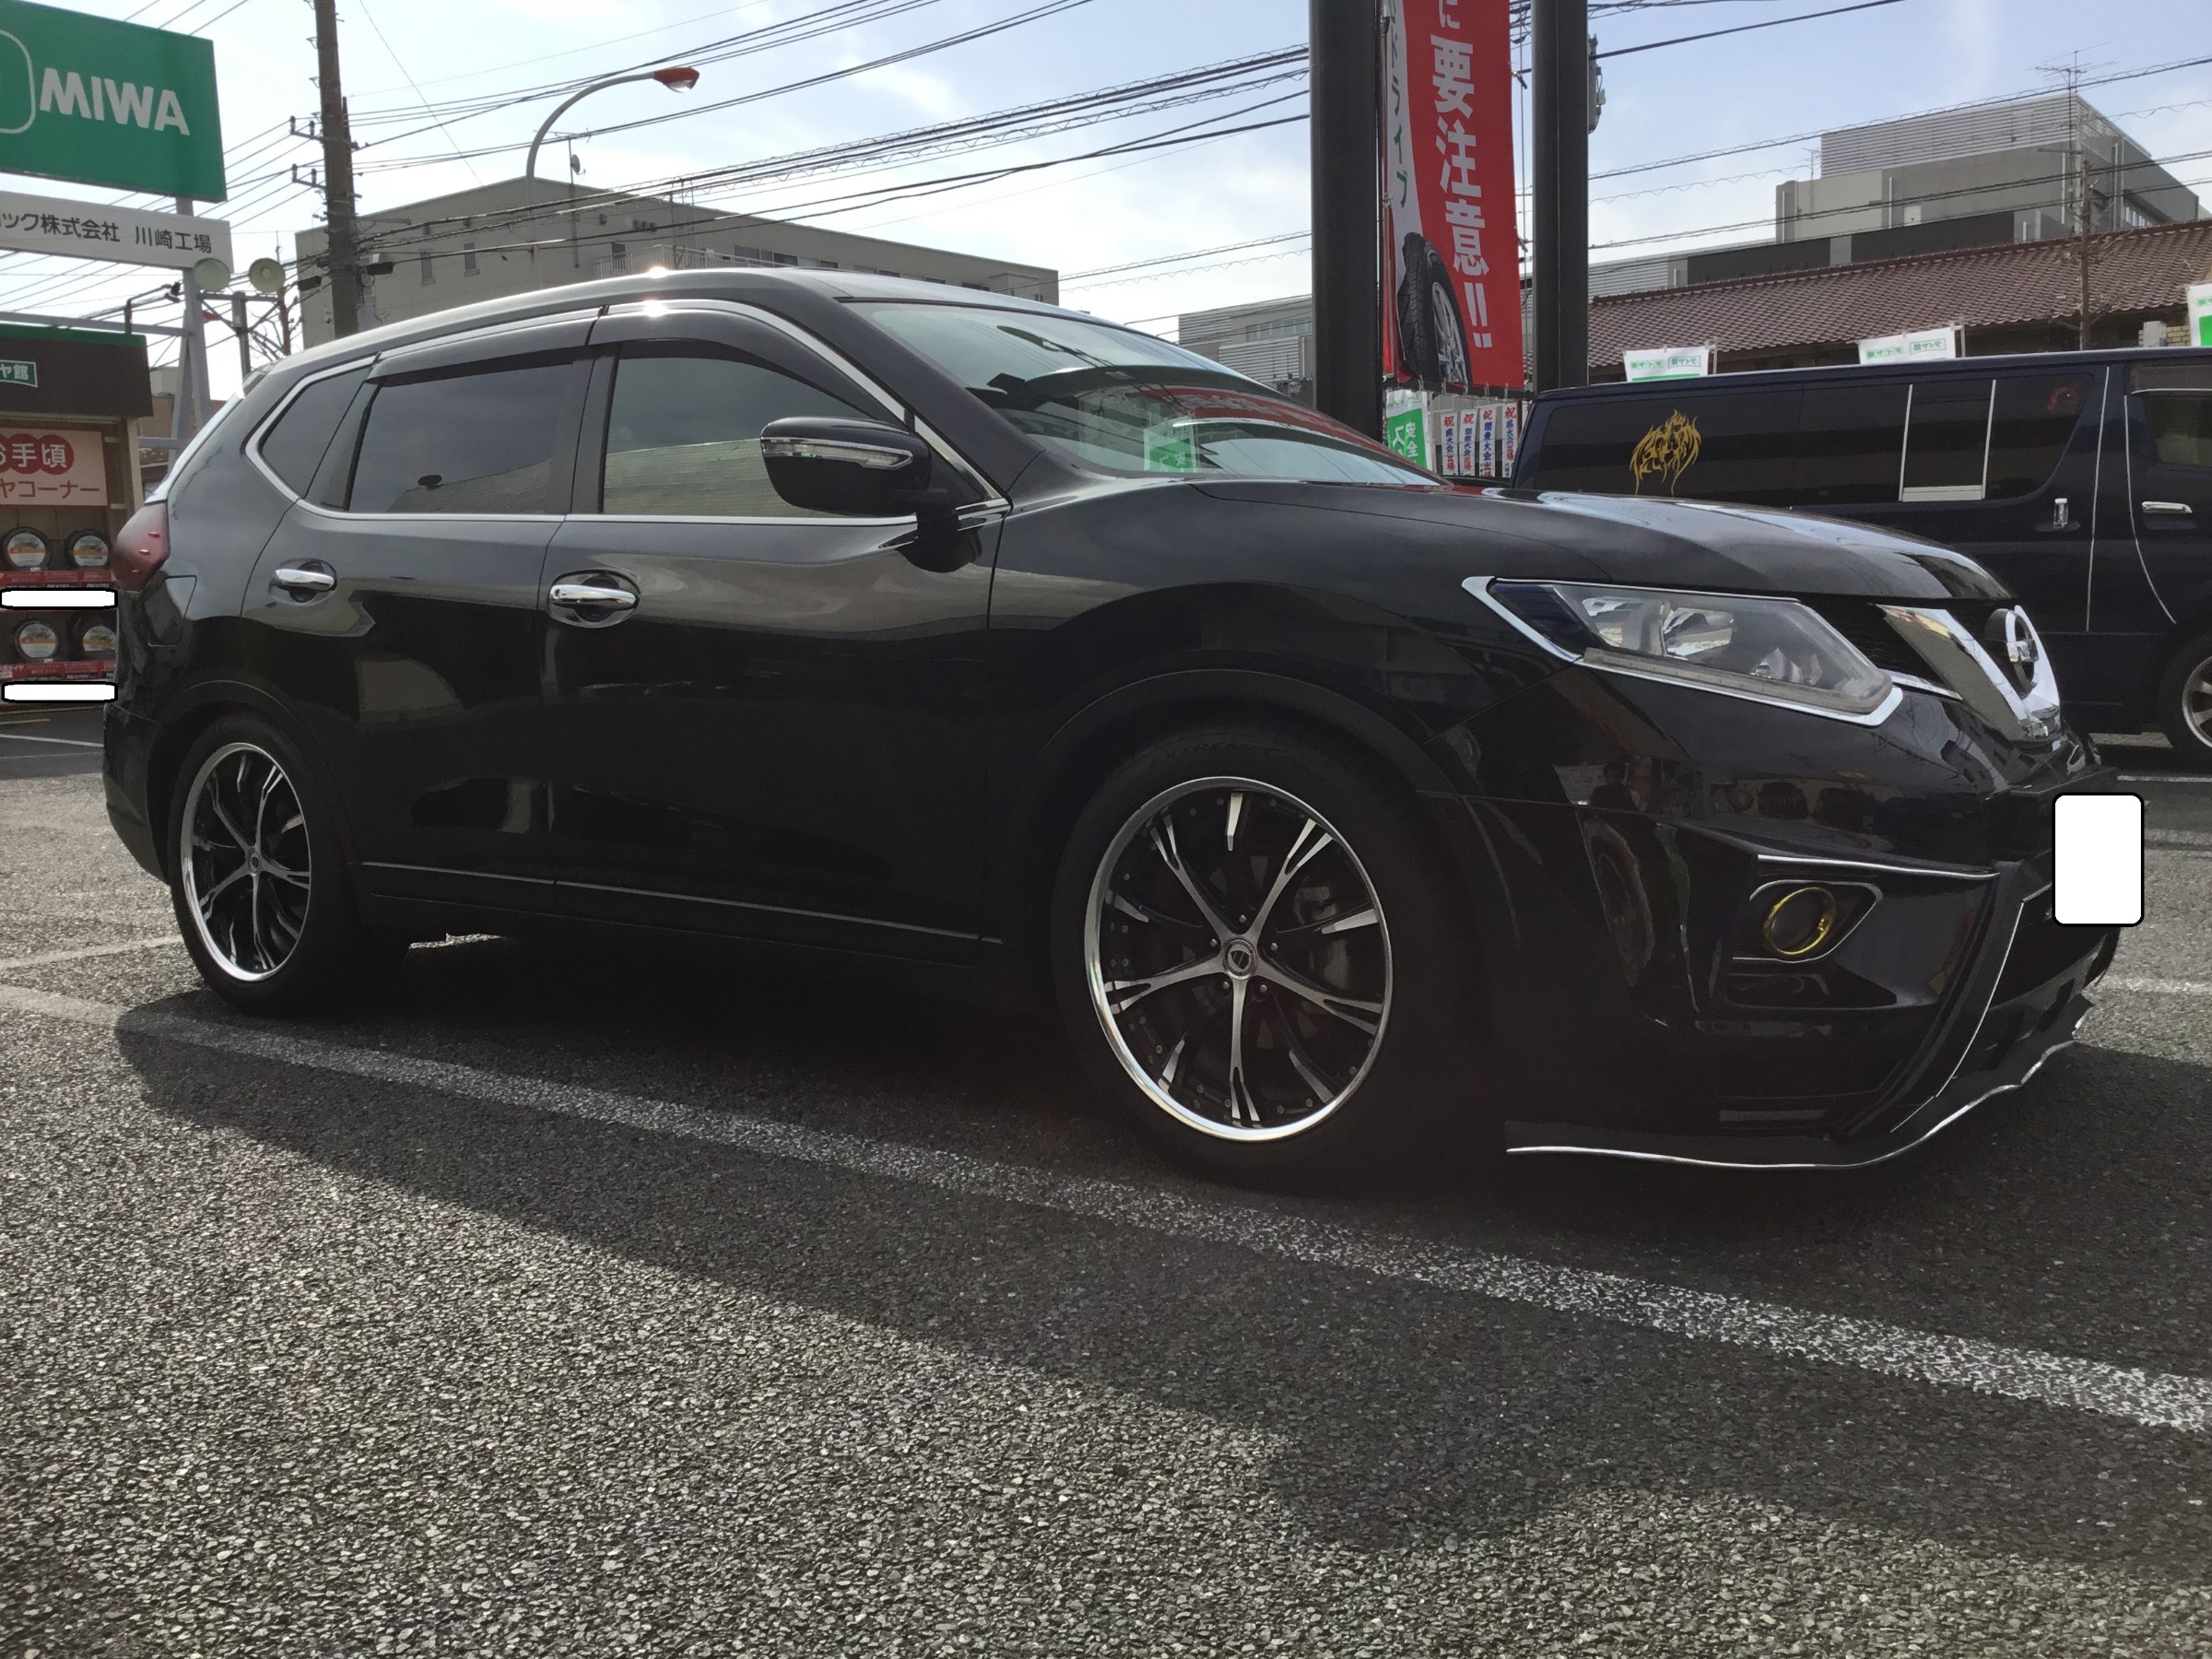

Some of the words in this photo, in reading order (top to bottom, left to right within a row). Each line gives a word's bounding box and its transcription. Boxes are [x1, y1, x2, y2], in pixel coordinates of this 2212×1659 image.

[40, 67, 191, 135] MIWA
[0, 212, 121, 242] ック株式会社
[135, 226, 212, 254] 川崎工場
[0, 443, 67, 468] 手頃
[0, 479, 100, 499] ヤコーナー
